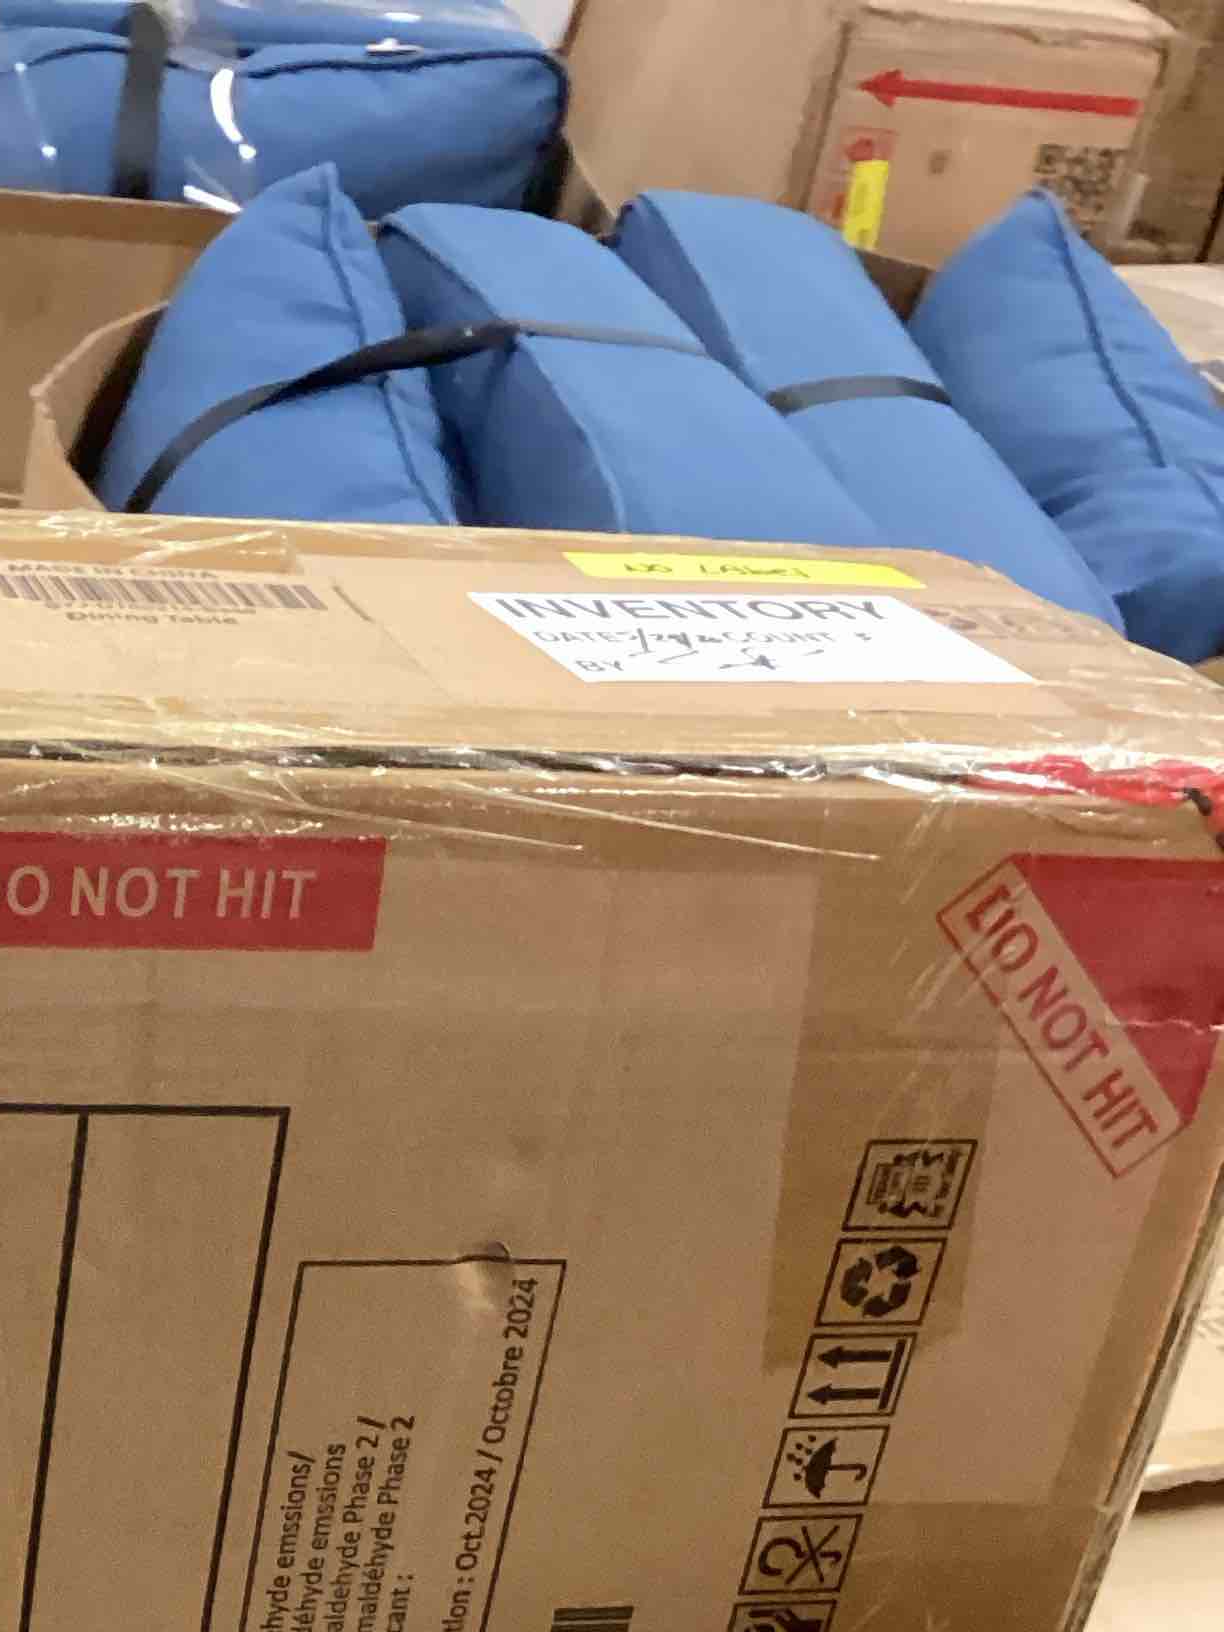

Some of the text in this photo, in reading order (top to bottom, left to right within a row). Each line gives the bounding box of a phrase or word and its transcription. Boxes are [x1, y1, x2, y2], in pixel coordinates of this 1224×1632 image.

[495, 598, 888, 621] INVENTORY
[70, 867, 199, 919] NOT
[217, 869, 315, 920] HIT
[1019, 974, 1110, 1074] NOT
[1084, 1059, 1159, 1152] HIT
[501, 1278, 539, 1339] 2024
[484, 1346, 522, 1443] Octobre
[344, 1456, 374, 1523] Phase
[378, 1437, 409, 1504] Phase
